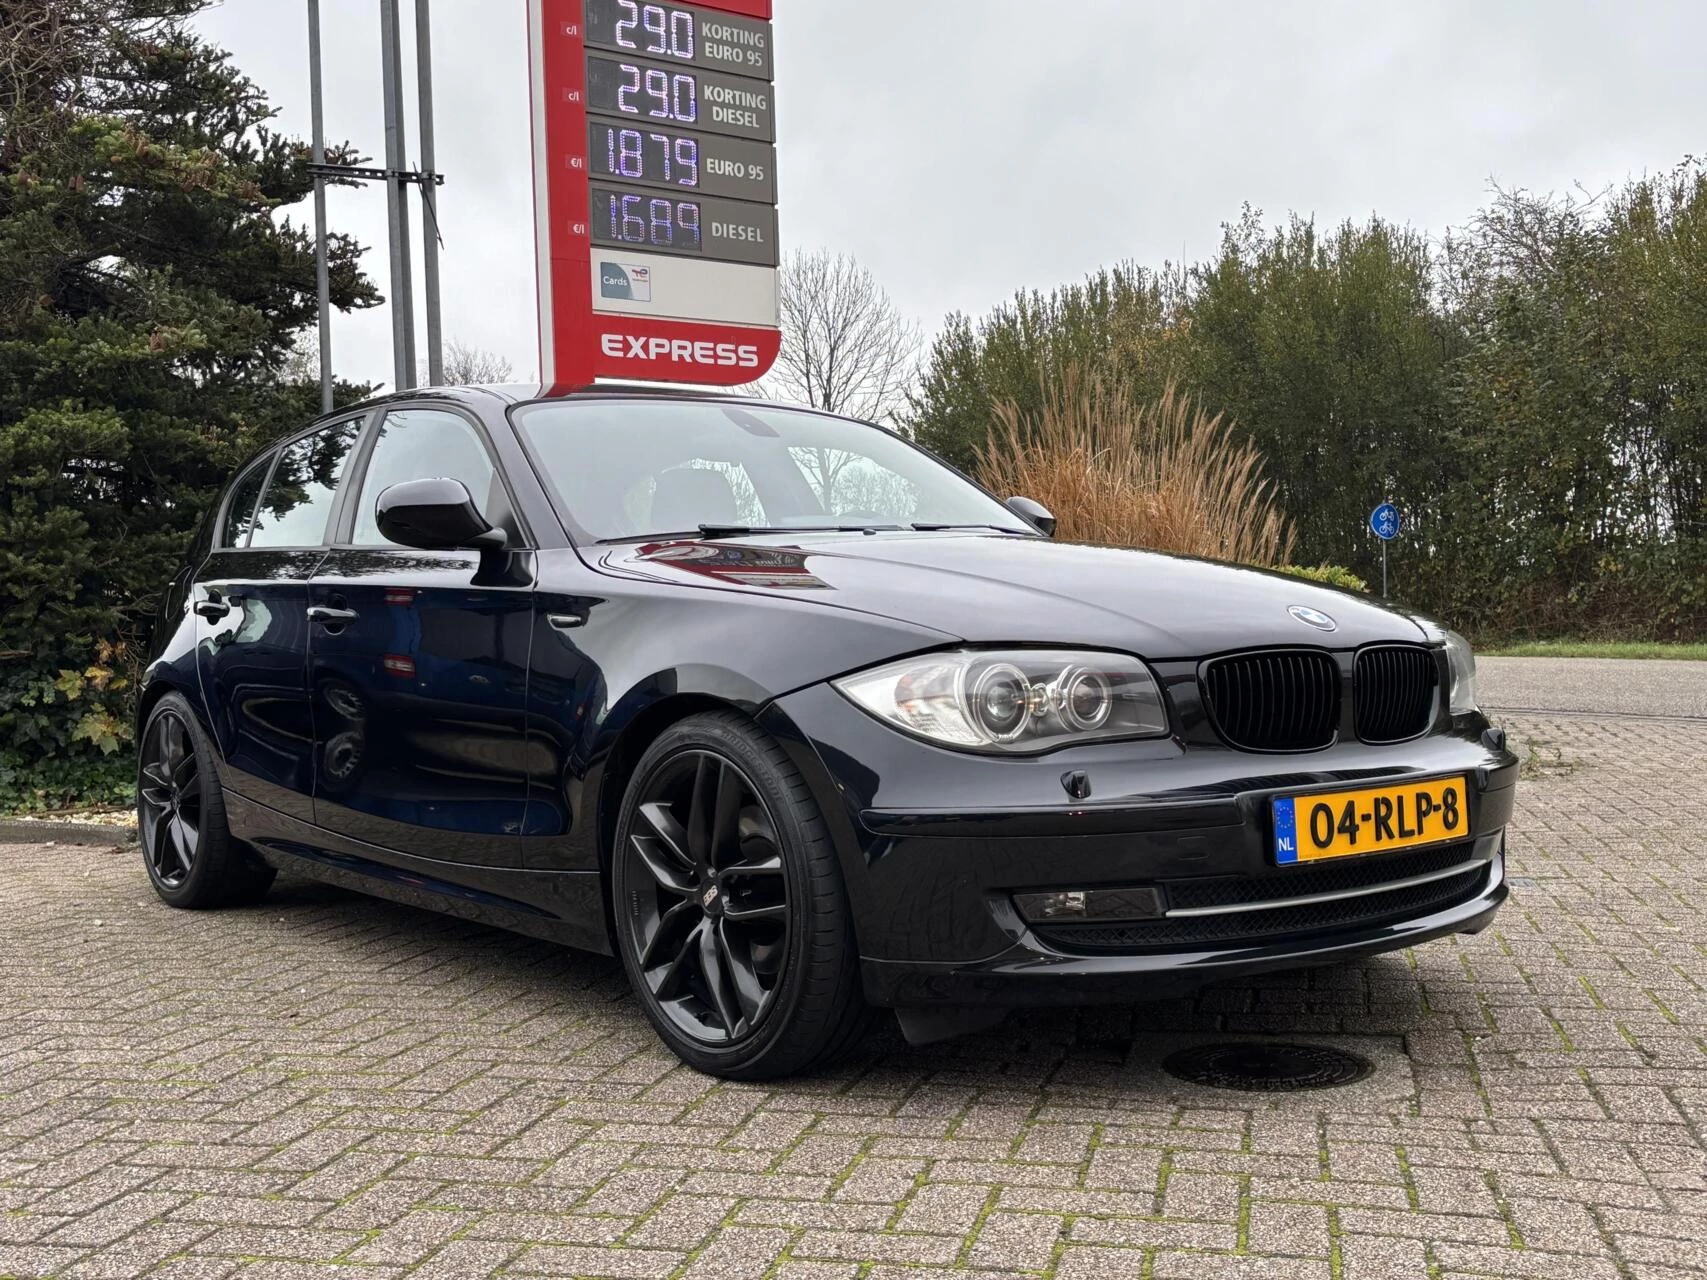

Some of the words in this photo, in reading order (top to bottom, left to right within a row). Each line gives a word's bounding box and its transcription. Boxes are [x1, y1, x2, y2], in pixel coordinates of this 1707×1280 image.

[566, 25, 577, 36] c/l
[616, 0, 694, 60] 29.0
[702, 22, 765, 48] KORTING
[705, 43, 743, 63] EURO
[747, 52, 762, 66] 95
[568, 91, 579, 102] c/l
[618, 64, 696, 122] 29.0
[704, 85, 767, 110] KORTING
[712, 106, 760, 128] DIESEL
[570, 157, 582, 168] €/l
[608, 128, 697, 186] 1.879
[706, 158, 744, 178] EURO
[748, 165, 764, 181] 95
[573, 223, 585, 235] €/l
[711, 222, 764, 242] DIESEL
[603, 276, 628, 286] Cards
[601, 333, 759, 367] EXPRESS
[1310, 787, 1459, 849] 04-RLP-8
[1278, 837, 1294, 851] NL
